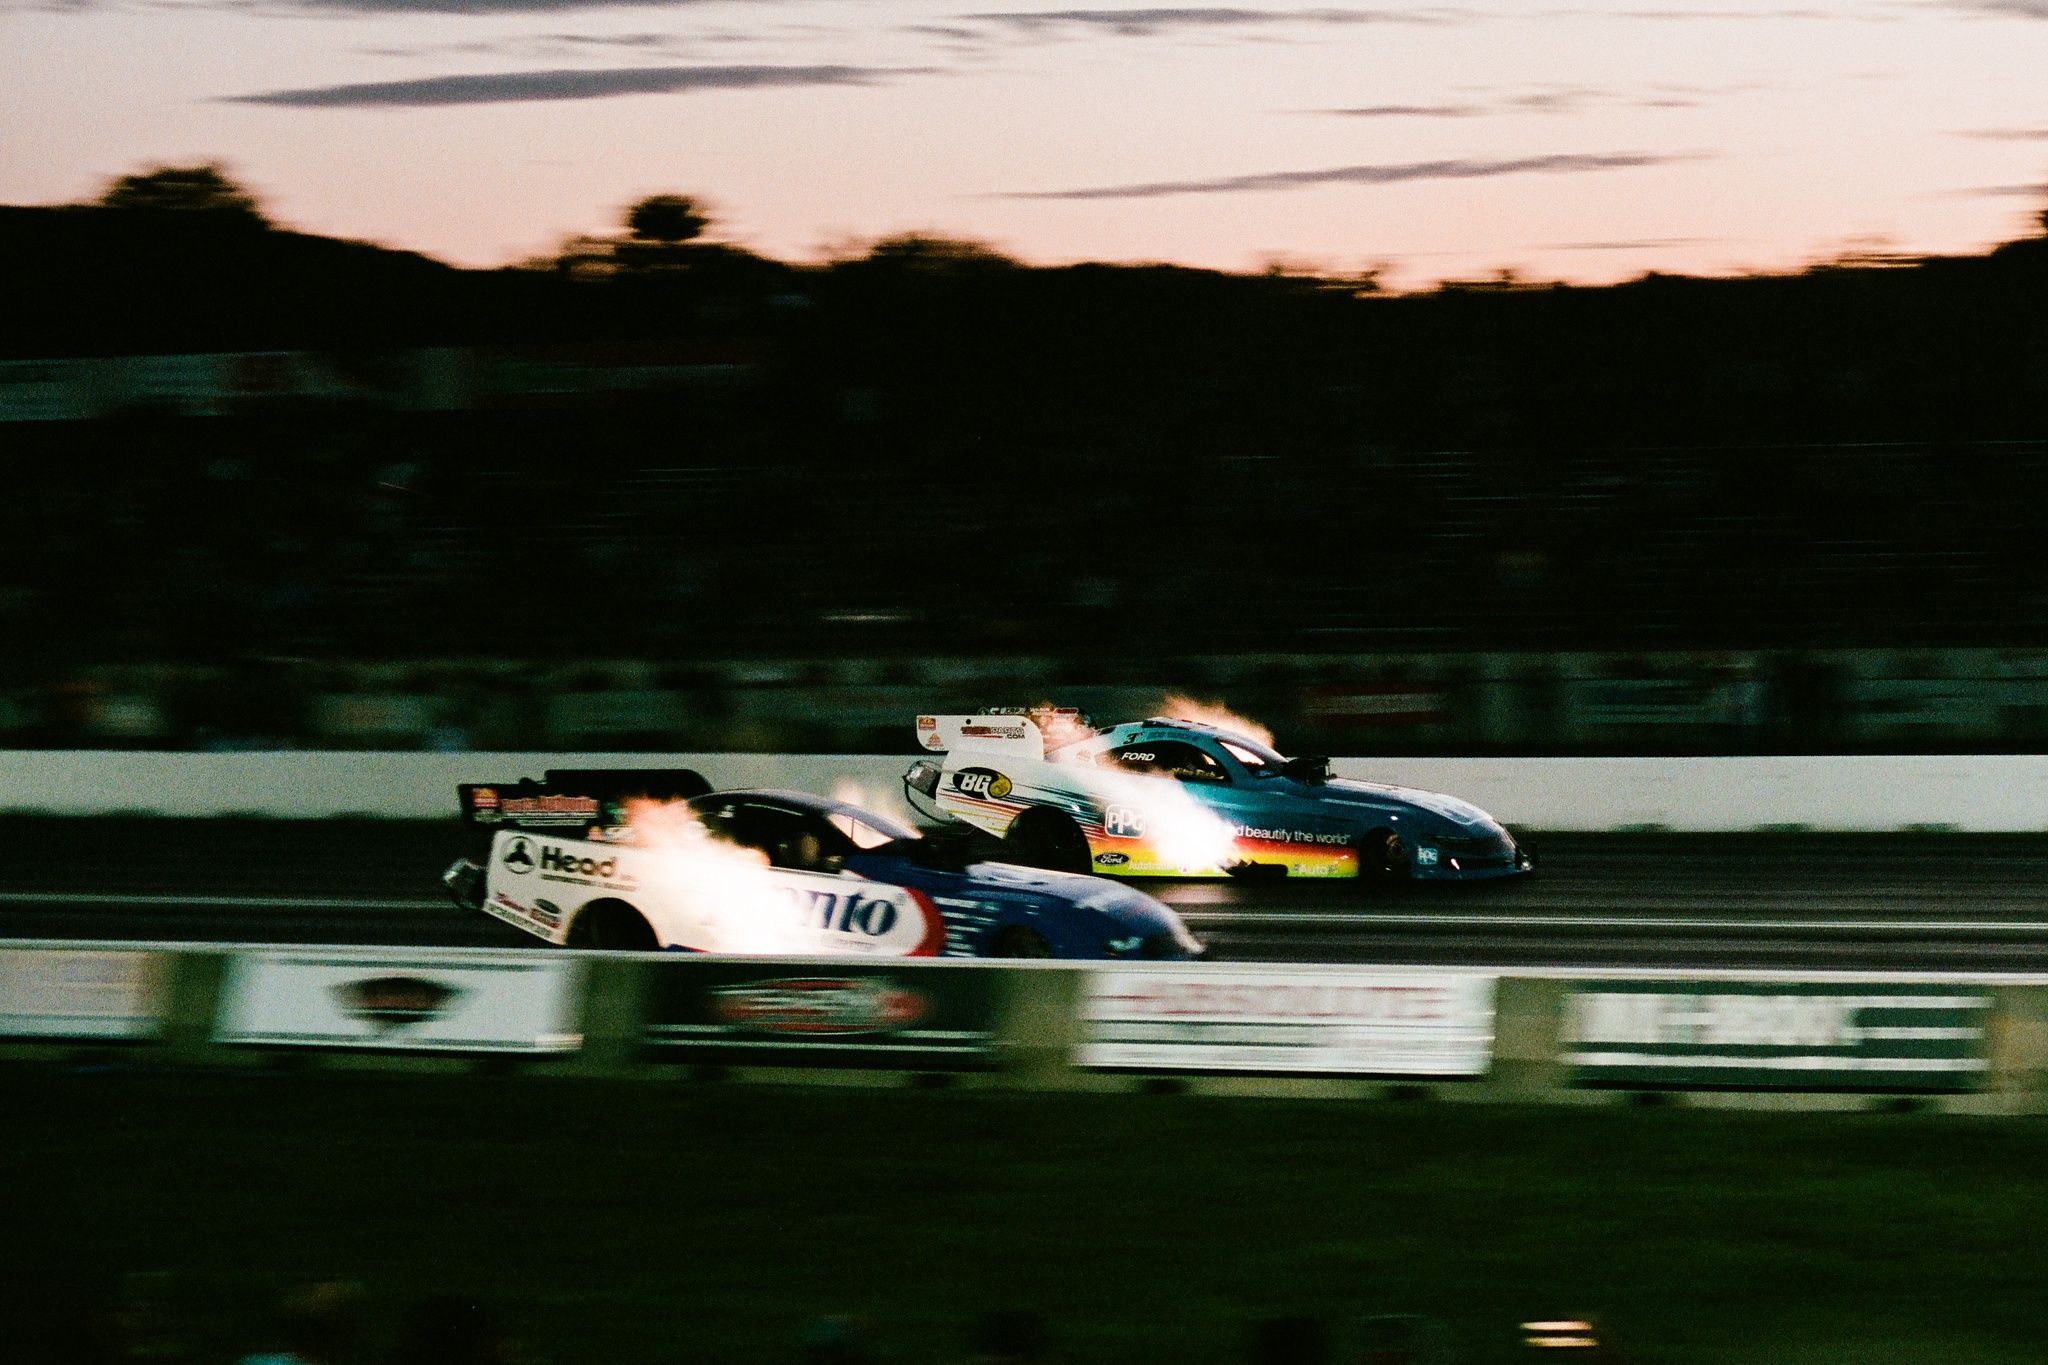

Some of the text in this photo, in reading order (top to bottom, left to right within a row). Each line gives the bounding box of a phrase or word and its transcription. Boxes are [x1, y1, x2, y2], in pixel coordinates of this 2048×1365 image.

[1121, 751, 1156, 762] FORD
[960, 773, 992, 793] BG
[1245, 824, 1293, 843] beautify
[1293, 829, 1315, 843] the
[540, 845, 618, 878] Head
[1100, 853, 1124, 865] Ford
